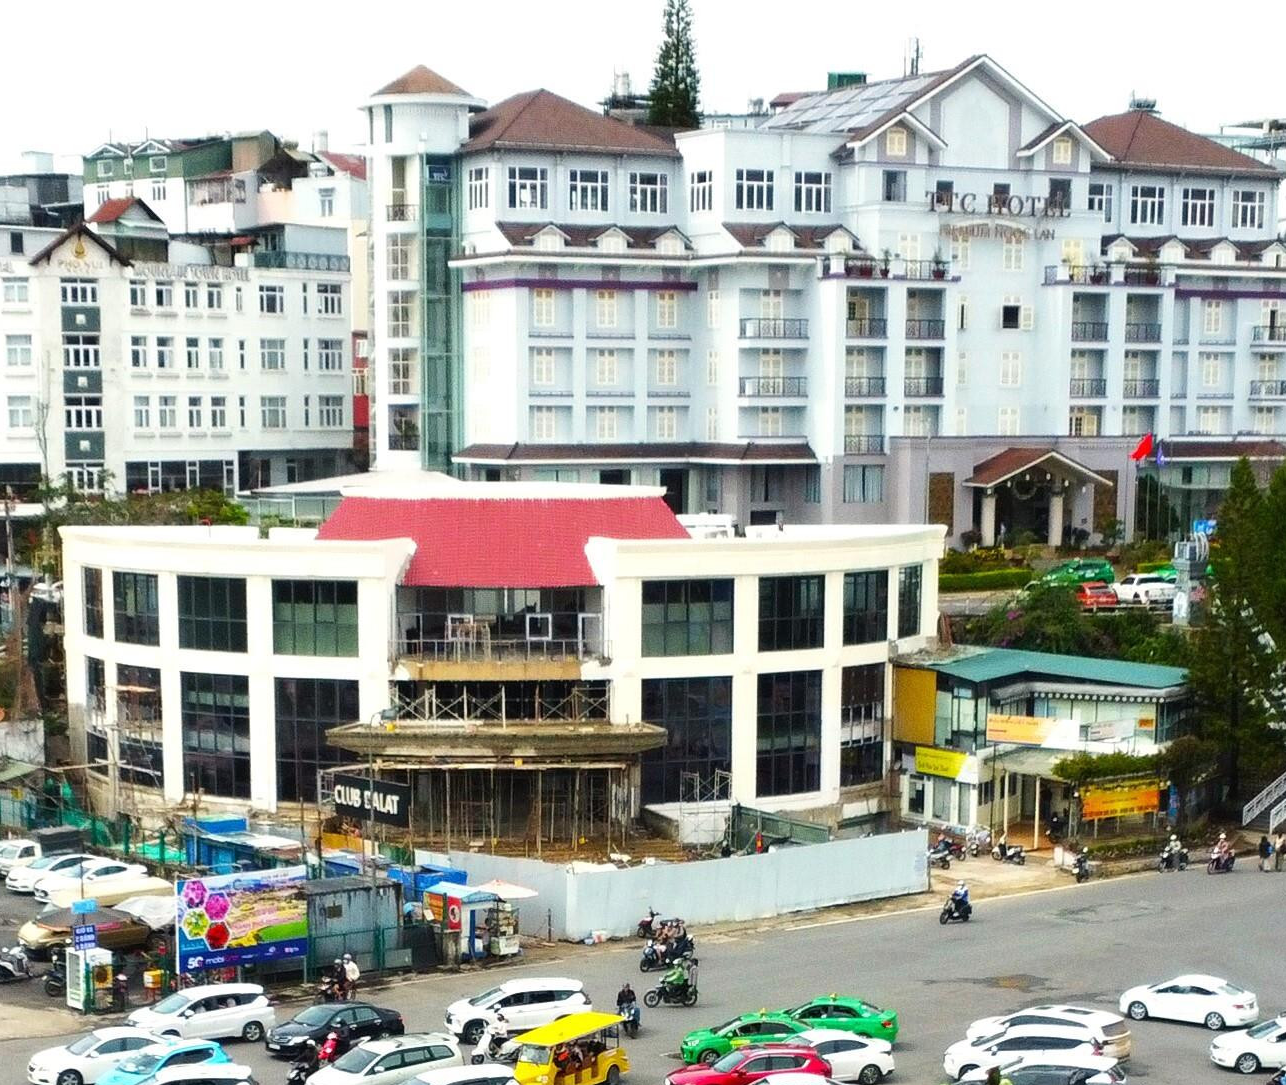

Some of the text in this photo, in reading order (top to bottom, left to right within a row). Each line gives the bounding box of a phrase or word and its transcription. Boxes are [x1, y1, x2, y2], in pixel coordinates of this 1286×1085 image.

[925, 190, 1071, 218] TTC HOTEL
[1034, 228, 1055, 241] LAN
[335, 784, 362, 808] CLUB
[187, 956, 204, 969] 5G
